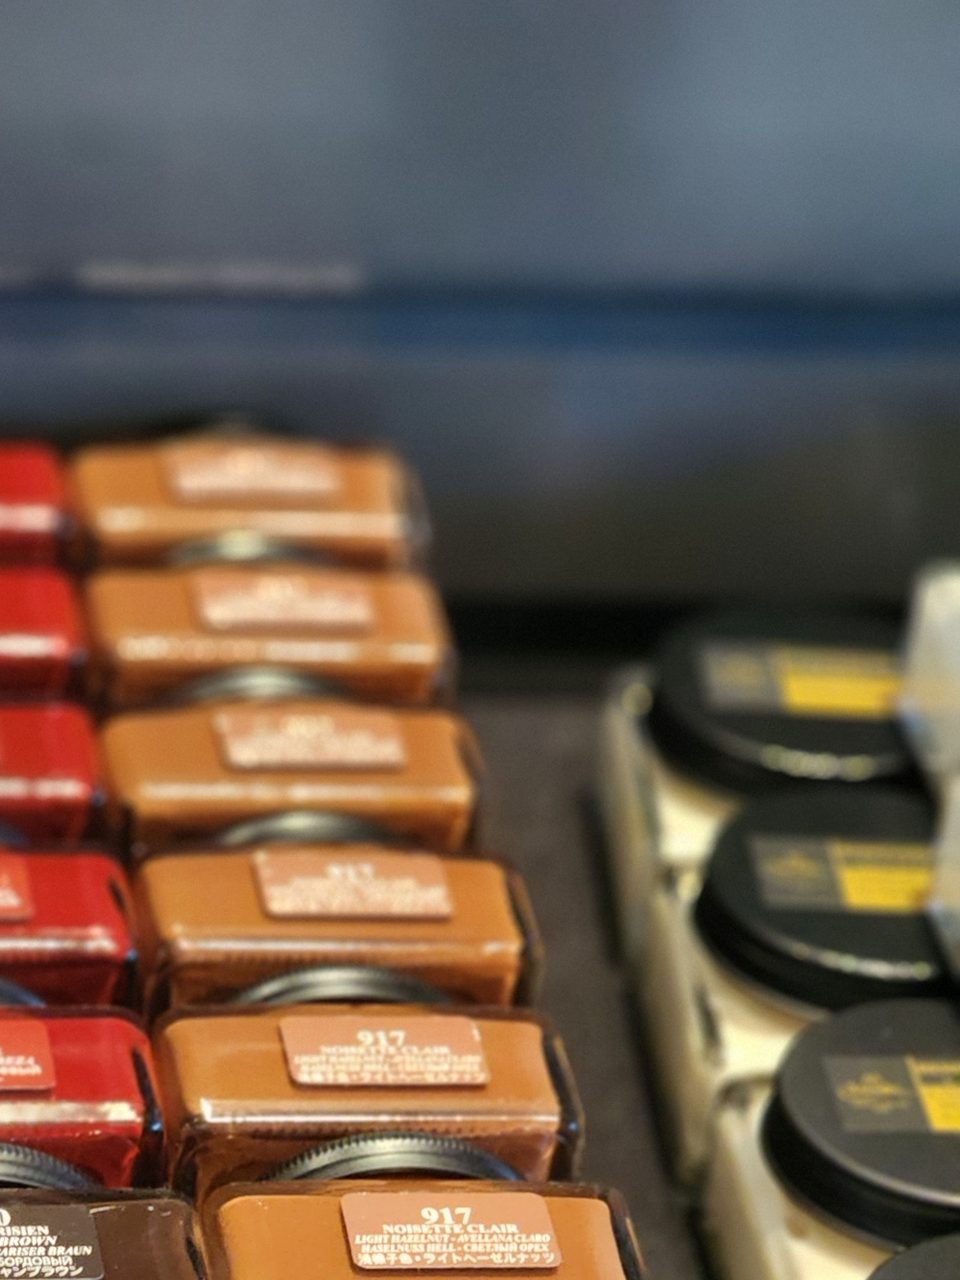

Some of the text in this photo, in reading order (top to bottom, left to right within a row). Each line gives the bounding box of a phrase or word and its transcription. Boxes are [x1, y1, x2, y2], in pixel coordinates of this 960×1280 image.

[357, 1030, 406, 1046] 917
[421, 1207, 471, 1224] 917
[382, 1224, 519, 1234] NOISETTE CLAIR
[355, 1234, 550, 1244] LIGHT HAZELNUT AVELLANA CLARO
[48, 1246, 92, 1255] BRAUN
[361, 1244, 423, 1253] HASELNUSS
[426, 1243, 456, 1253] HELL
